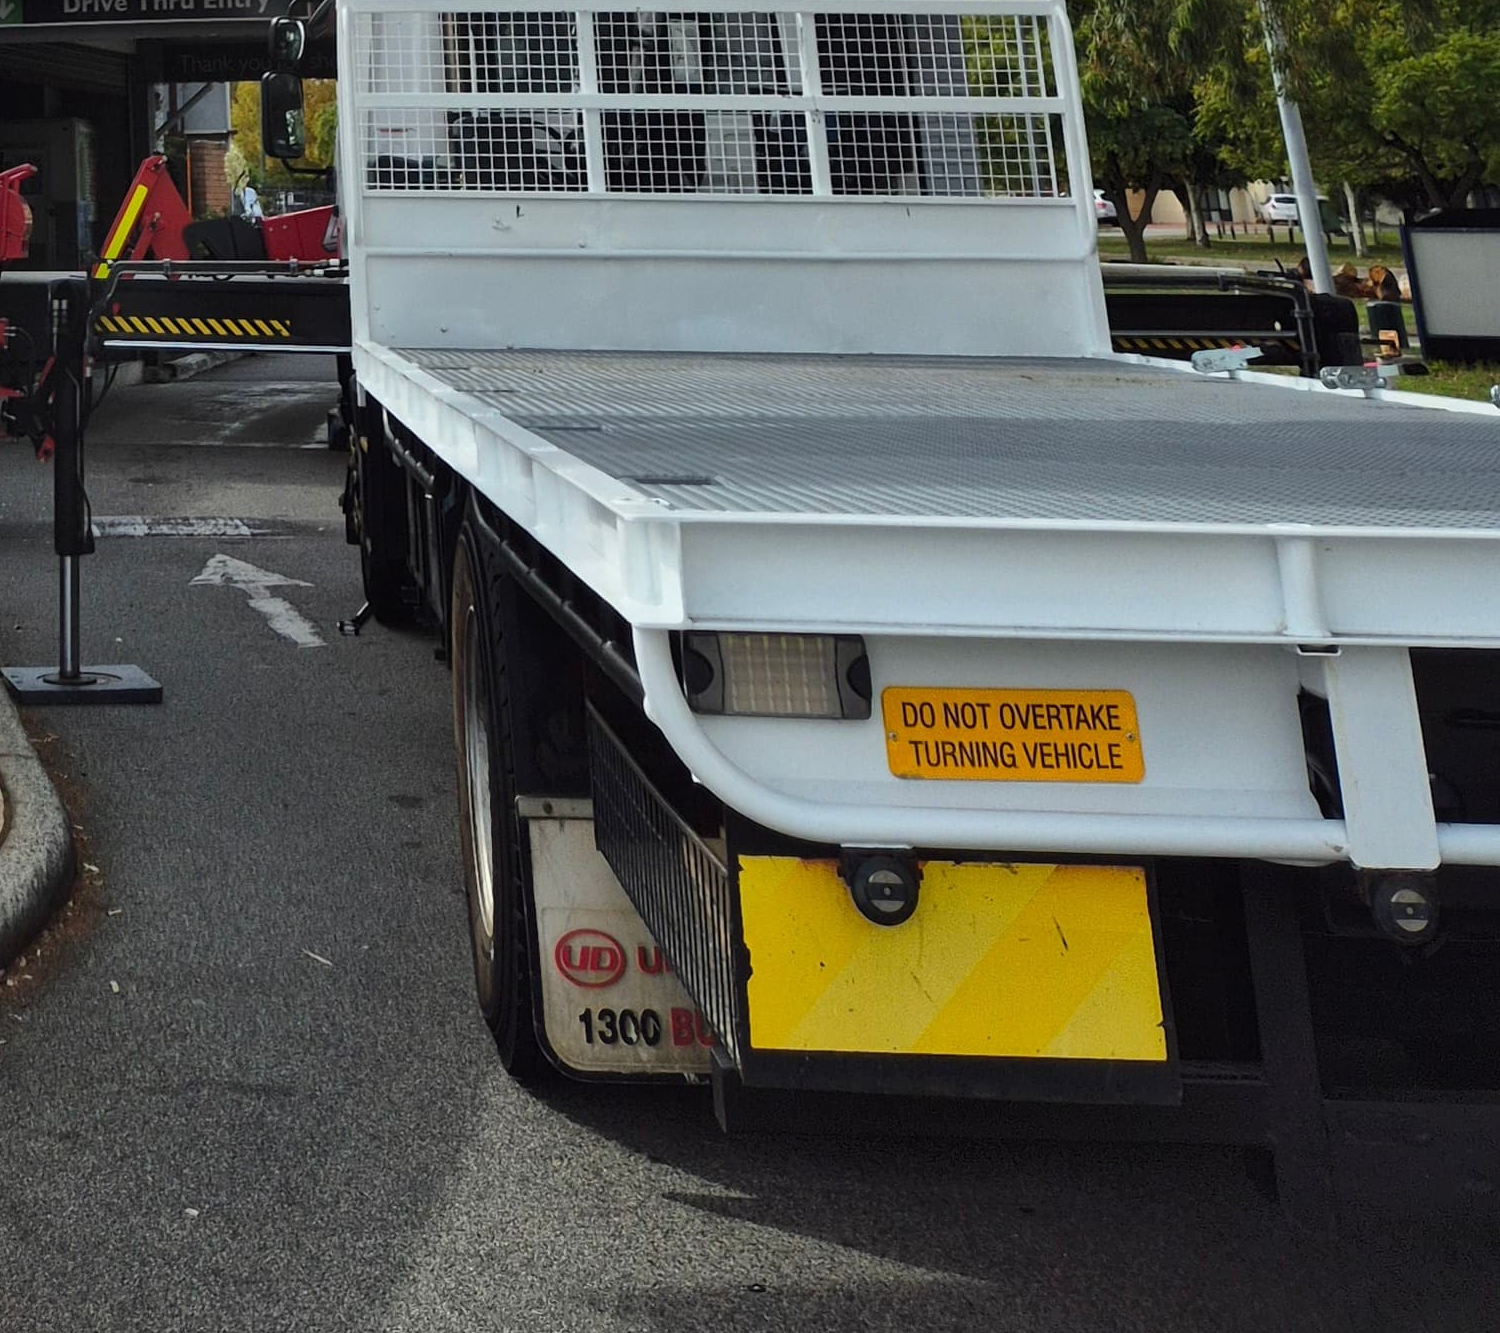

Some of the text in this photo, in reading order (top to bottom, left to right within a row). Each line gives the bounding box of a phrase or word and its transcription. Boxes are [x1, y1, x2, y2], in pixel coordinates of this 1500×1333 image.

[180, 53, 232, 72] Thank
[236, 56, 272, 76] you
[901, 701, 1122, 731] DO NOT OVERTAKE
[908, 740, 1124, 770] TURNING VEHICLE
[637, 945, 676, 974] U
[578, 1007, 717, 1048] 1300 BU
